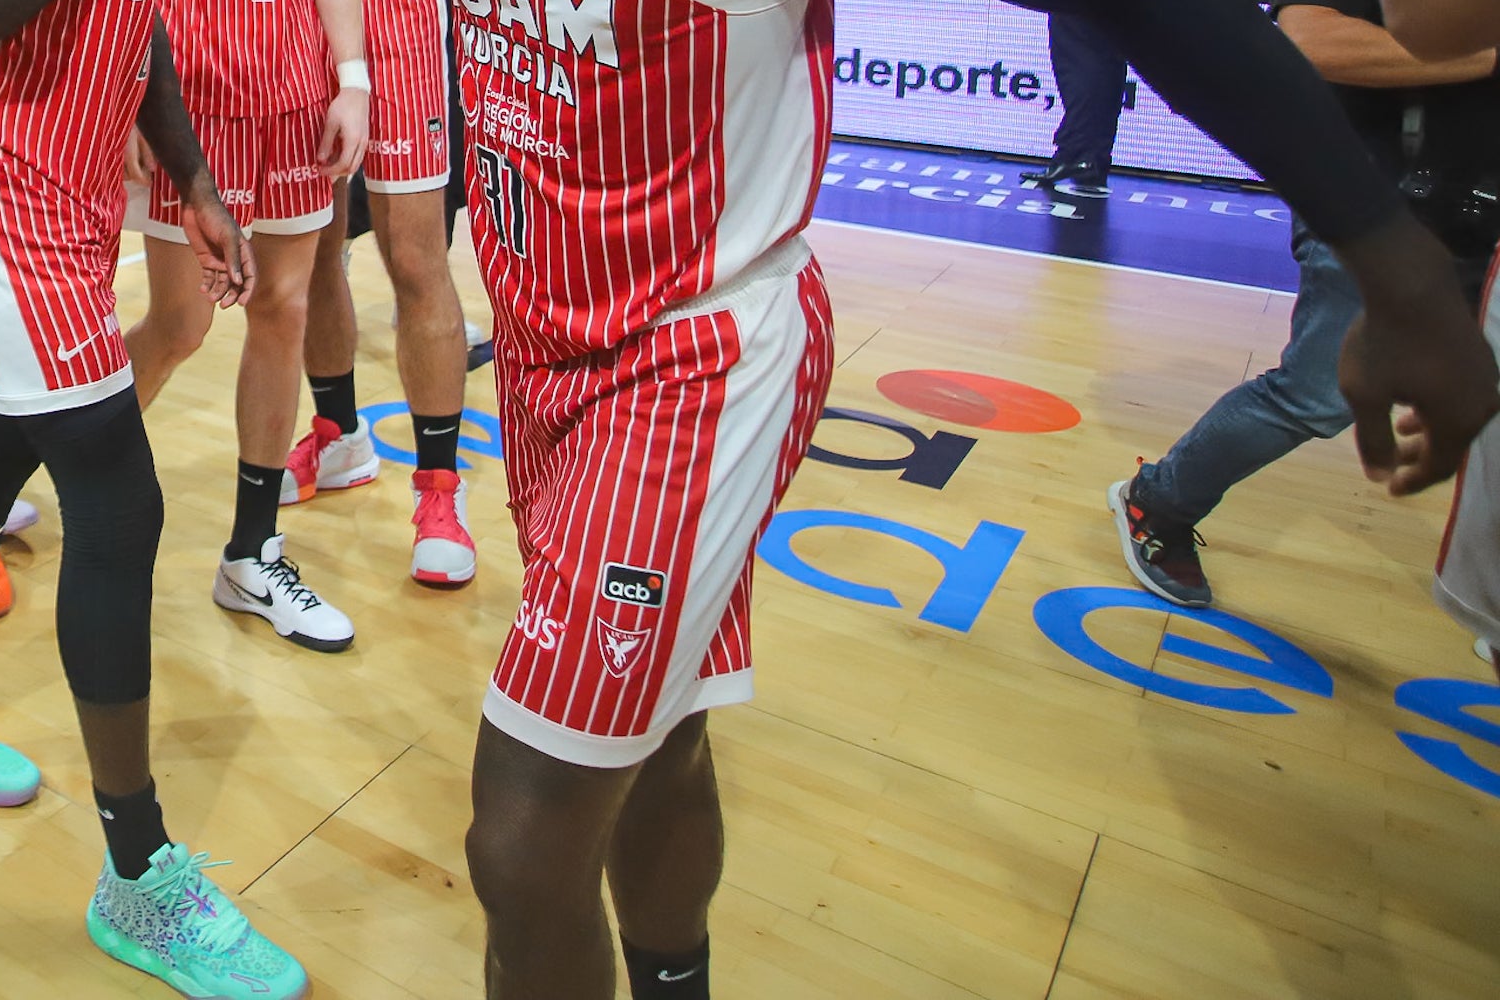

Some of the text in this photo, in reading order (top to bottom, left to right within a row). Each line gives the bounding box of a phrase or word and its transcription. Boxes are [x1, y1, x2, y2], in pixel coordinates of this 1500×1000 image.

[460, 22, 577, 108] MURCIA
[834, 48, 1056, 111] deporte,
[484, 101, 537, 135] REGIÓN
[483, 119, 570, 160] DE MURCIA
[608, 580, 651, 601] acb
